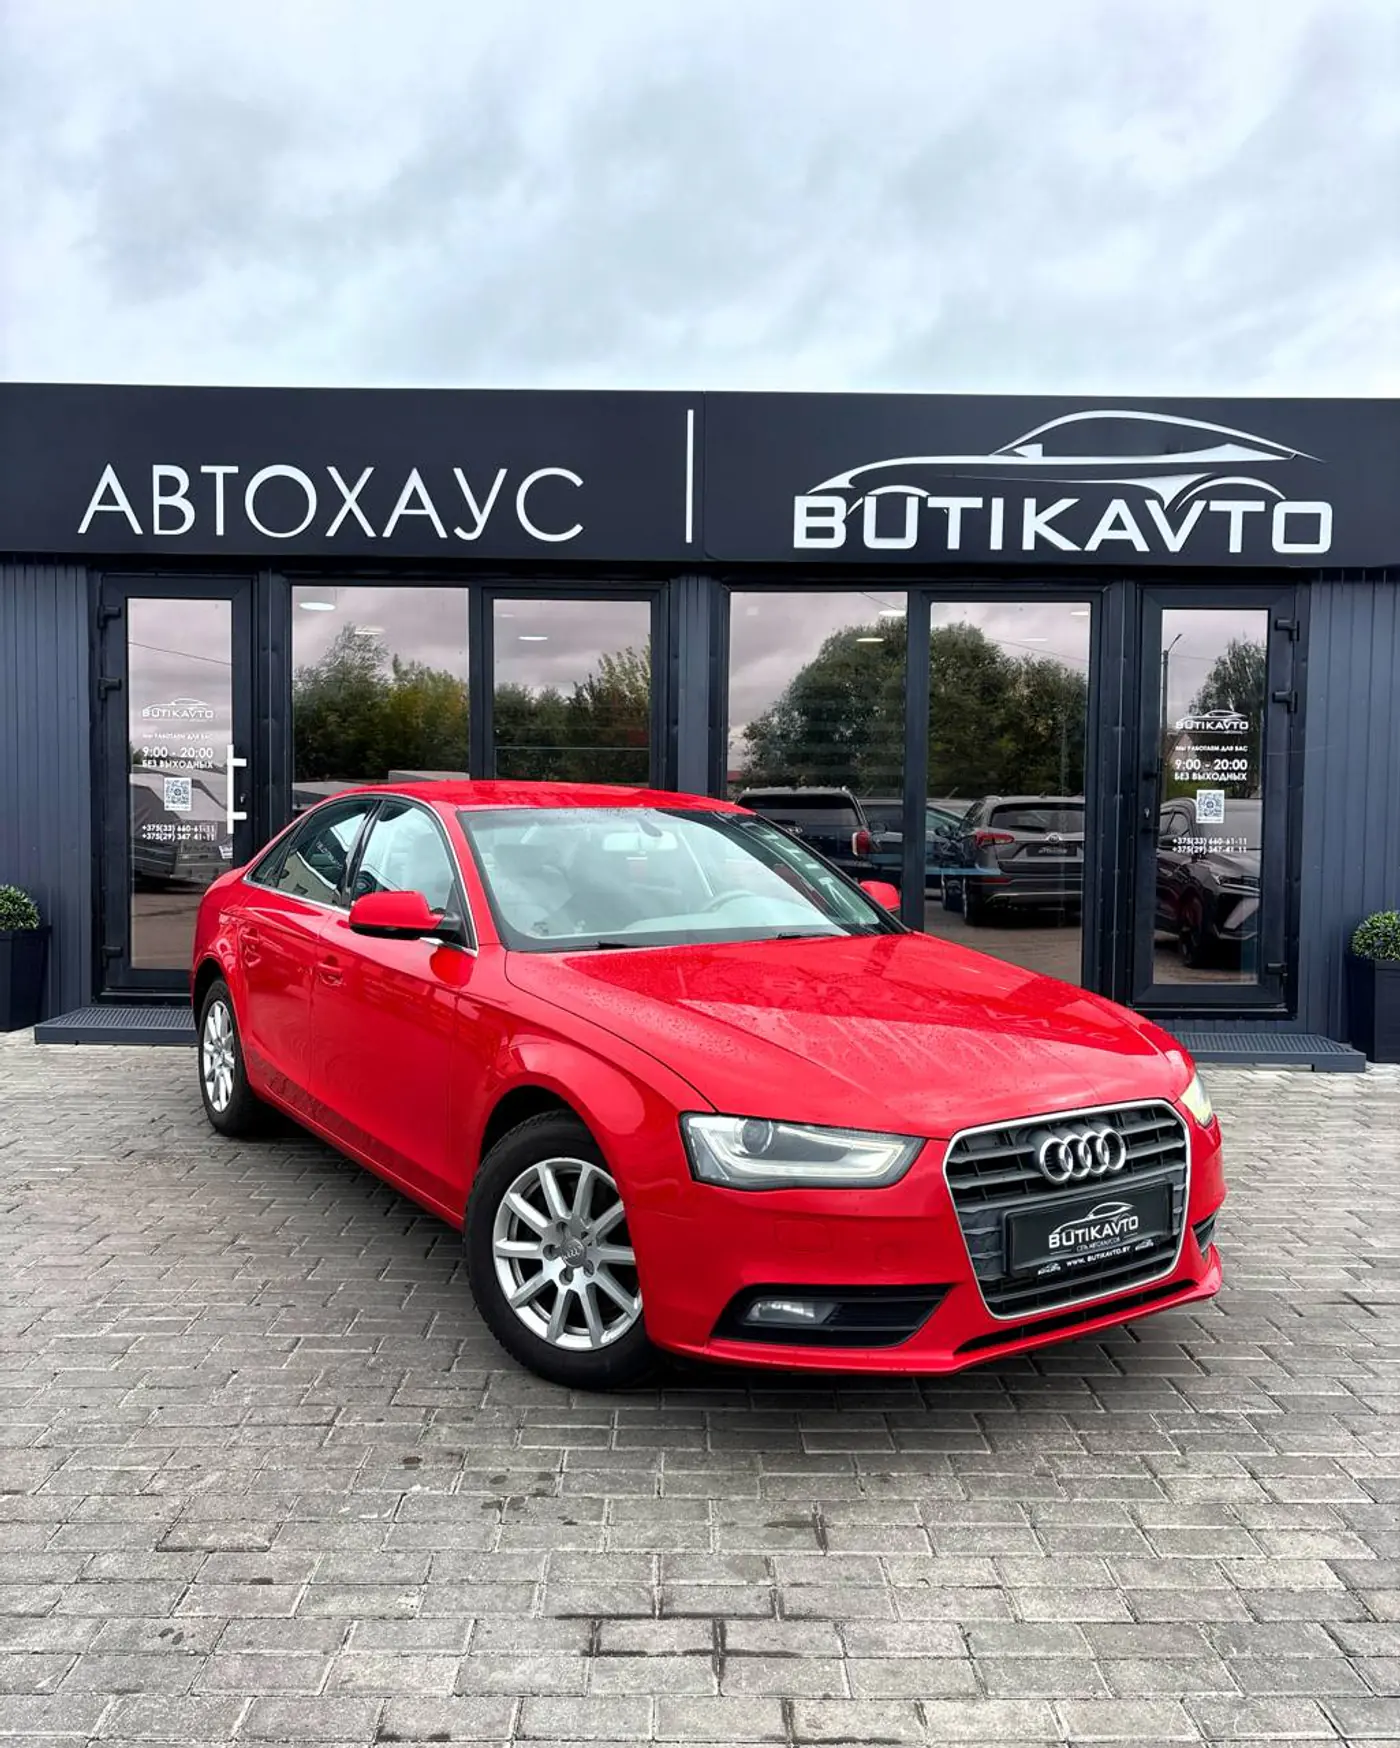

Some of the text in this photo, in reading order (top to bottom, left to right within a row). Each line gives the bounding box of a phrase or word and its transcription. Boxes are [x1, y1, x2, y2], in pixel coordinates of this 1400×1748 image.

[77, 463, 585, 542] АВТОХАУС
[793, 494, 1333, 554] BUTIKAVTO
[142, 708, 214, 719] BUTIKAVTO
[1175, 720, 1249, 731] BUTIKAVTO
[142, 746, 168, 757] 9:00
[180, 747, 213, 758] 20:00
[142, 760, 213, 769] БЕЗ ВЫХОДНЫХ
[1174, 759, 1201, 770] 9:00
[1213, 759, 1248, 770] 20:00
[1174, 772, 1247, 781] БЕЗ ВЫХОДНЫХ
[1048, 1215, 1139, 1249] BUTIKAVTO
